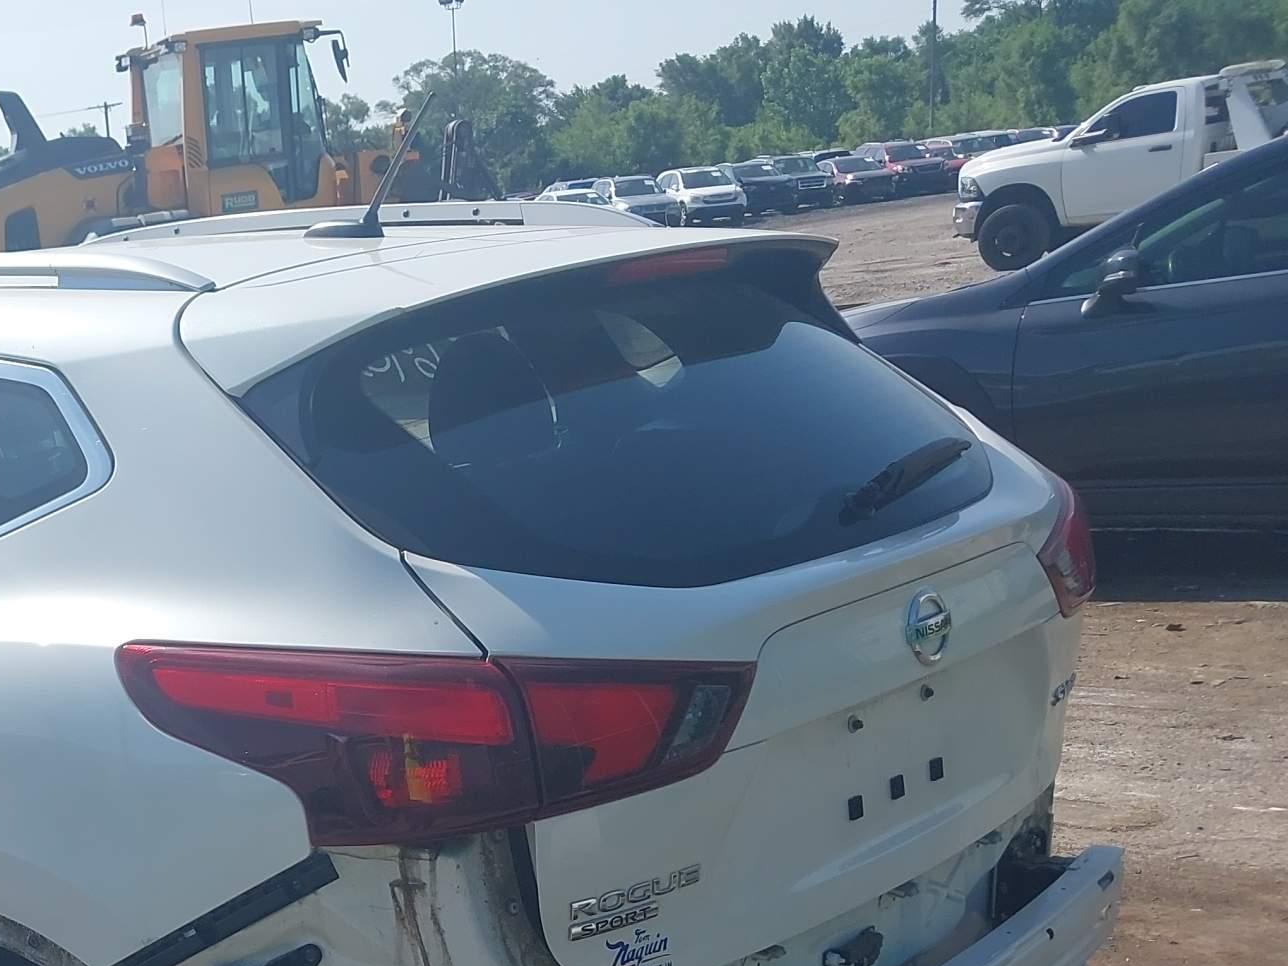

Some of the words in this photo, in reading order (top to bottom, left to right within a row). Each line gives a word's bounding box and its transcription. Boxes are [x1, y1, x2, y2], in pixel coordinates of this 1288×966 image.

[74, 159, 129, 175] VOLVO
[570, 863, 701, 921] ROGUE
[581, 905, 652, 937] SPORT
